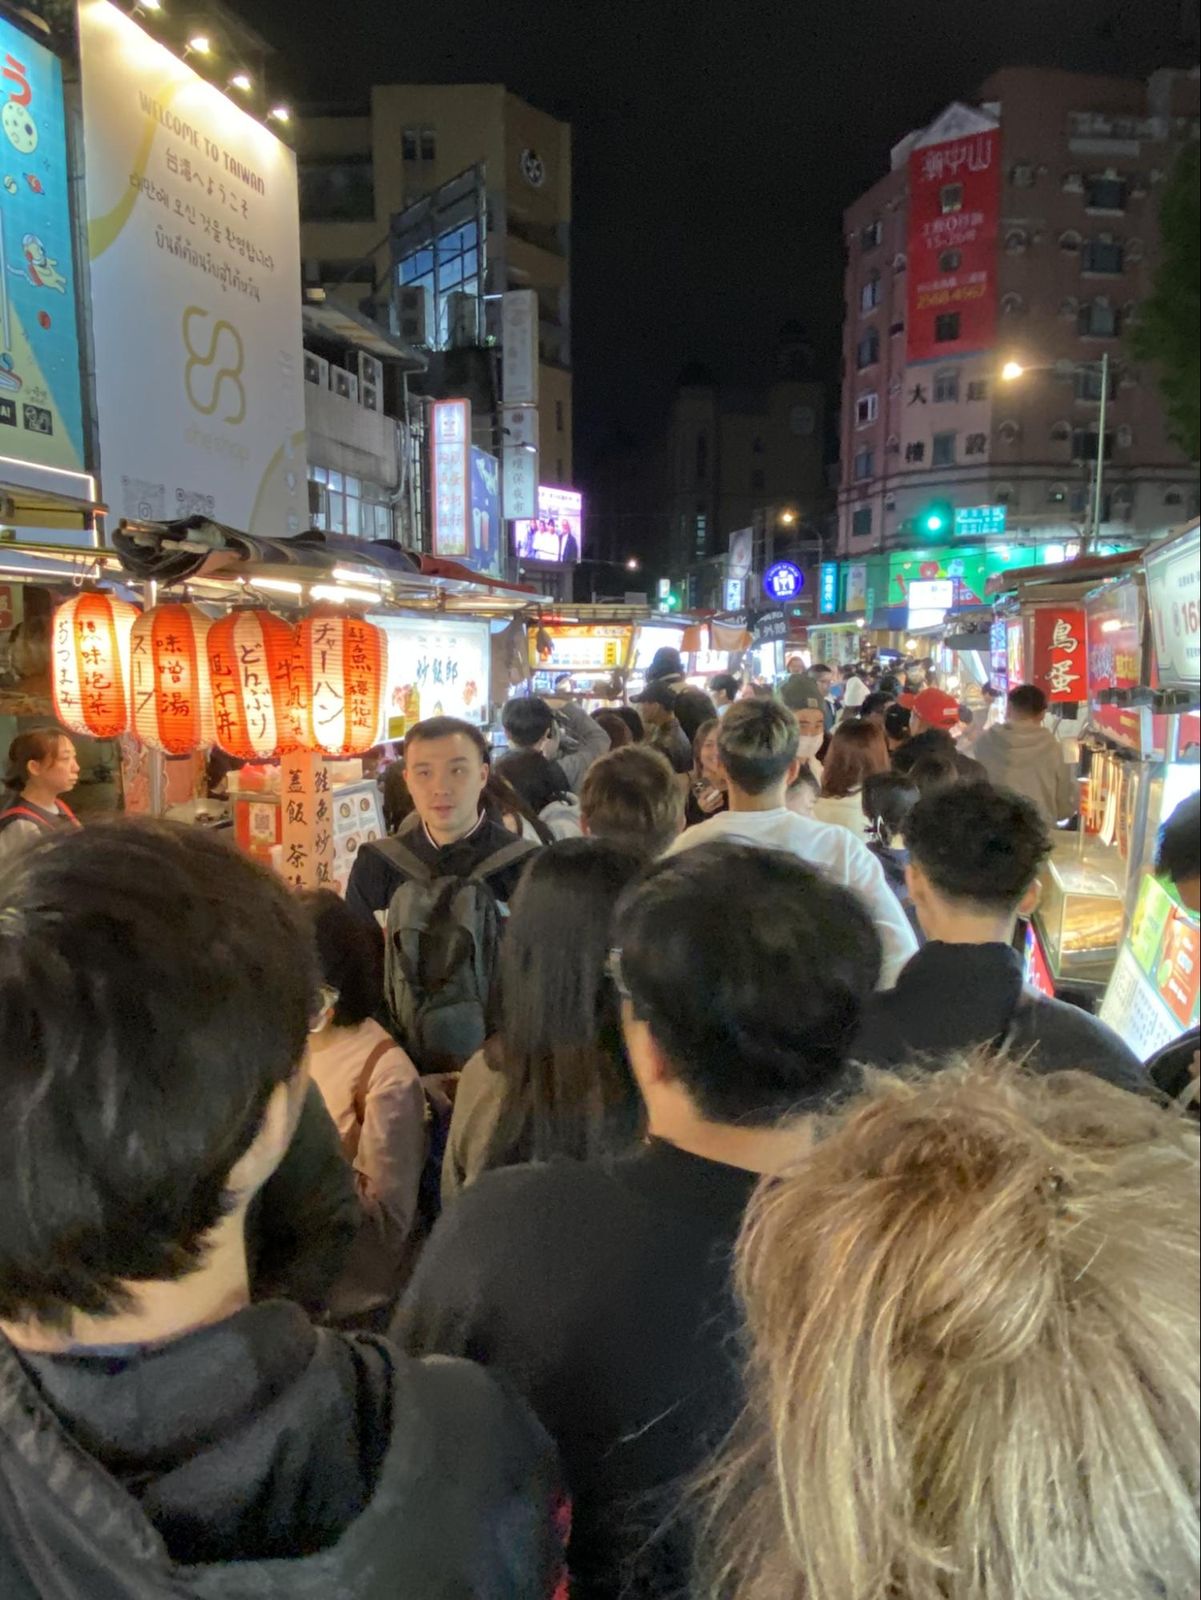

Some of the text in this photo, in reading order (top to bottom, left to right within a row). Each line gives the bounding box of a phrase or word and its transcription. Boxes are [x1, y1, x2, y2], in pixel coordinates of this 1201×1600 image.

[139, 90, 265, 195] WELCOME TO TAIWAN
[173, 198, 196, 225] 오신
[200, 212, 221, 243] 것을
[1045, 618, 1080, 694] 鳥蛋
[1181, 601, 1200, 635] 16
[240, 643, 271, 739] どんぶり
[313, 623, 345, 725] チャーハン
